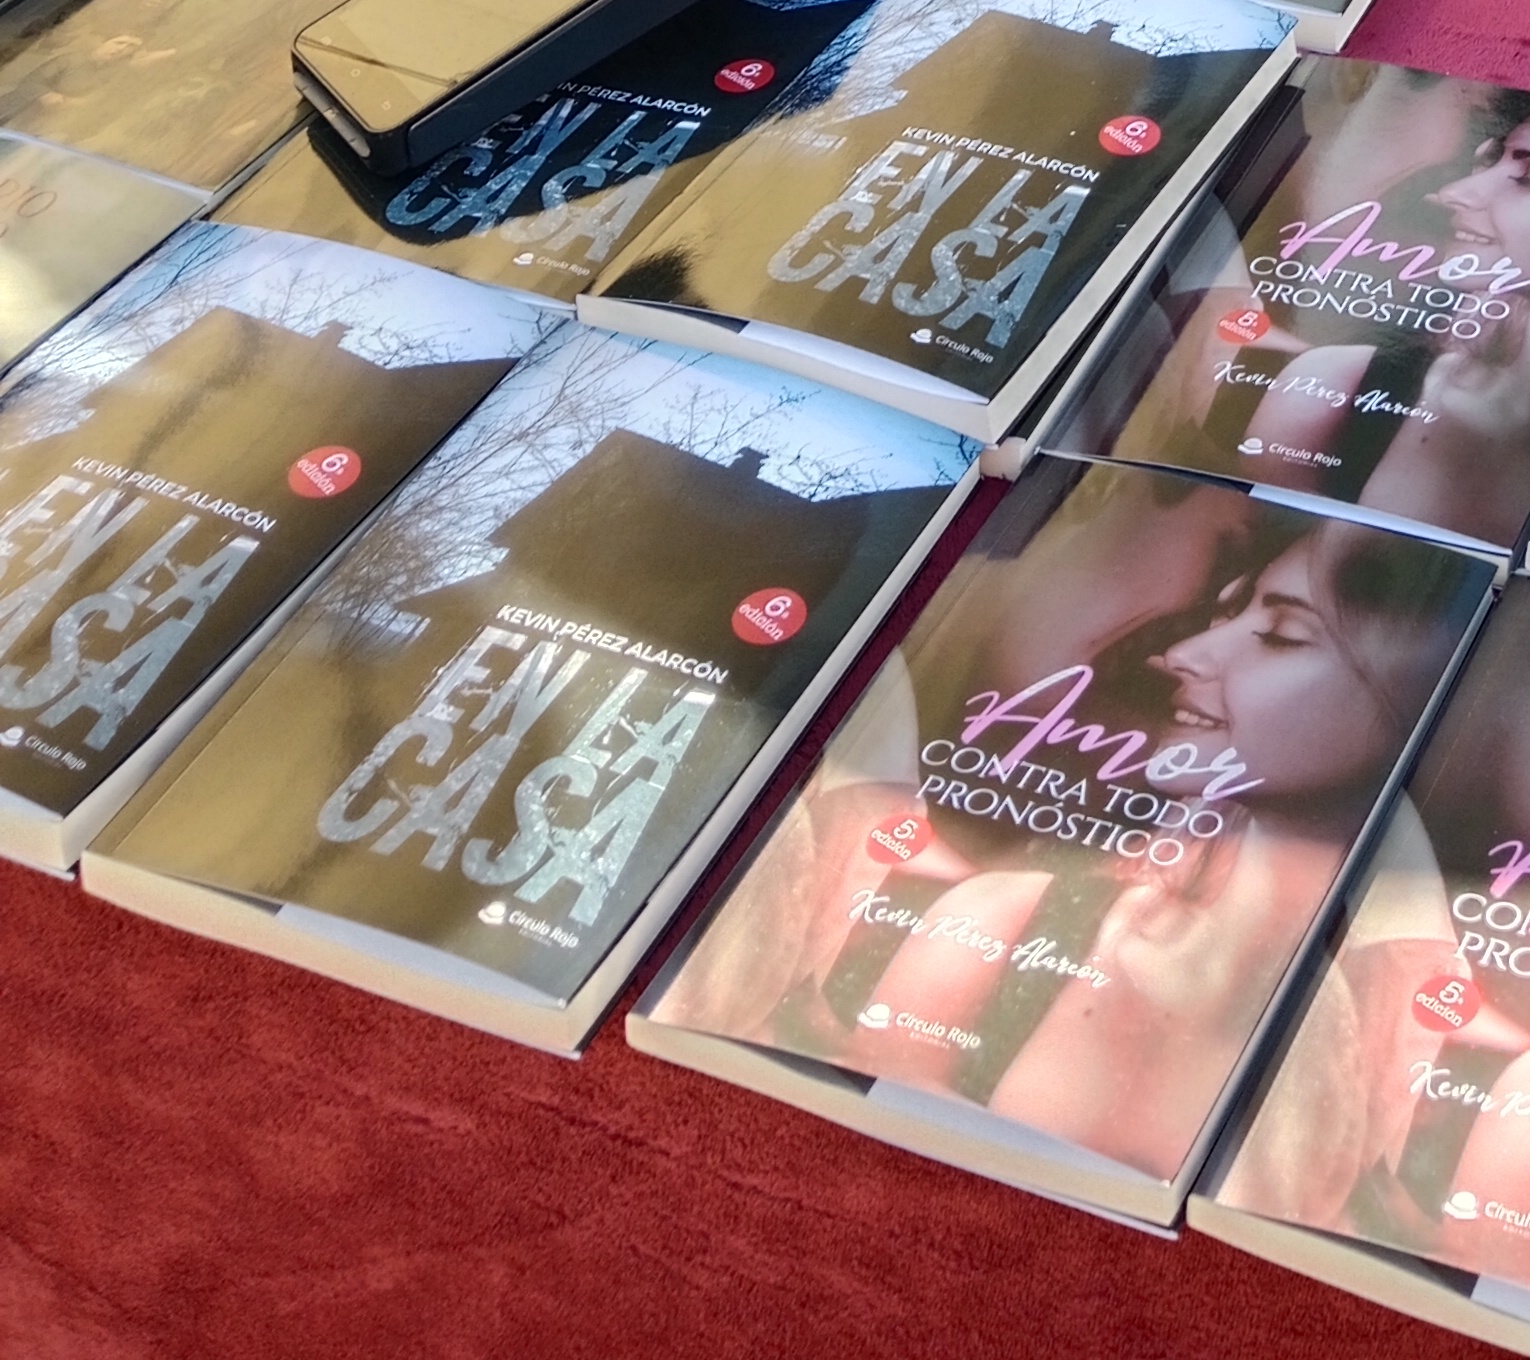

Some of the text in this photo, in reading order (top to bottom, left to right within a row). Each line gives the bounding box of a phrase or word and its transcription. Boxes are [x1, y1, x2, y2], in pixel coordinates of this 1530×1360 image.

[576, 83, 629, 104] PÉREZ
[629, 93, 712, 118] ALARCÓN
[583, 110, 701, 173] LA
[901, 126, 1100, 182] KEVIN PÉREZ ALARCÓN
[385, 147, 666, 263] CASA
[846, 139, 1091, 242] EN LA
[767, 200, 1058, 349] CASA
[1249, 256, 1511, 321] CONTRA TODO
[1250, 280, 1482, 340] PRONÓSTICO
[935, 334, 994, 365] Círculo Rojo
[1213, 361, 1441, 424] Kevin Pérez Alarcón
[1268, 441, 1312, 461] Círculo
[1312, 449, 1343, 468] Rojo
[72, 456, 278, 533] KEVIN PÉREZ ALARCÓN
[116, 513, 261, 612] LA
[497, 604, 729, 685] KEVIN PÉREZ ALARCÓN
[738, 603, 784, 641] edición
[418, 622, 717, 779] EN LA
[24, 734, 87, 772] Círculo Rojo
[960, 664, 1266, 802] Amor
[914, 774, 1186, 867] PRONÓSTICO
[920, 739, 1224, 839] CONTRA TODO
[316, 716, 670, 929] CASA
[507, 910, 551, 942] Círculo
[548, 922, 581, 949] Rojo
[849, 889, 1112, 990] Kevin Pérez Alarcón
[895, 1010, 983, 1051] Círculo Rojo
[1415, 991, 1463, 1028] edición
[1409, 1060, 1498, 1113] Kevin
